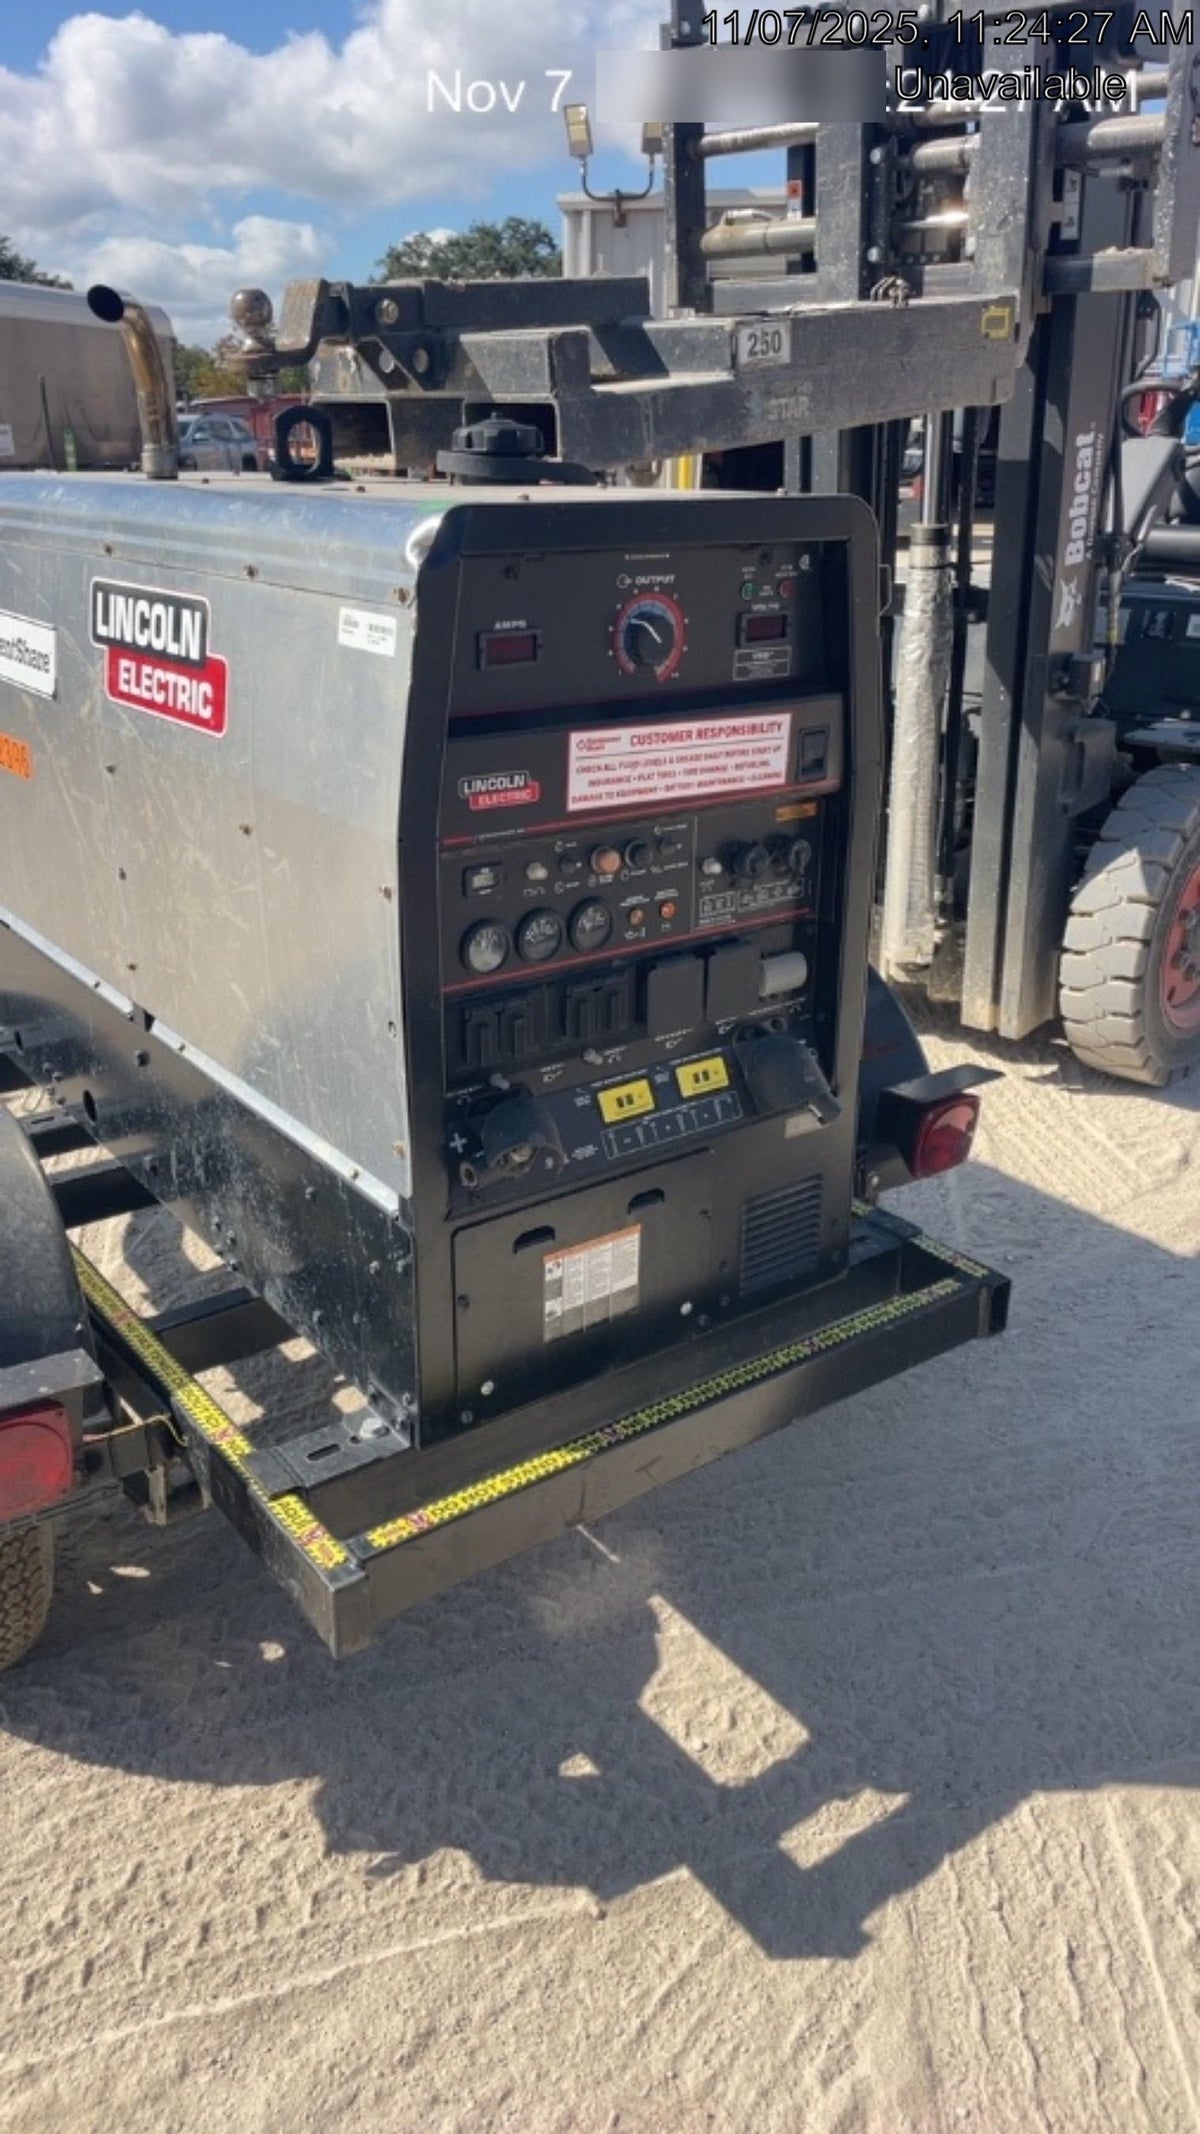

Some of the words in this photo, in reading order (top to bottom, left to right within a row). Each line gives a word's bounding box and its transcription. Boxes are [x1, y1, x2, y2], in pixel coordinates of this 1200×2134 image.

[747, 330, 782, 357] 250
[1064, 432, 1096, 566] Bobcat
[635, 574, 676, 586] OUTPUT
[96, 591, 201, 660] LINCOLN
[494, 620, 528, 631] AMPS
[118, 658, 213, 719] ELECTRIC
[629, 729, 694, 748] CUSTOMER
[696, 721, 784, 743] RESPONSIBILITY
[464, 774, 526, 796] LINCOLN
